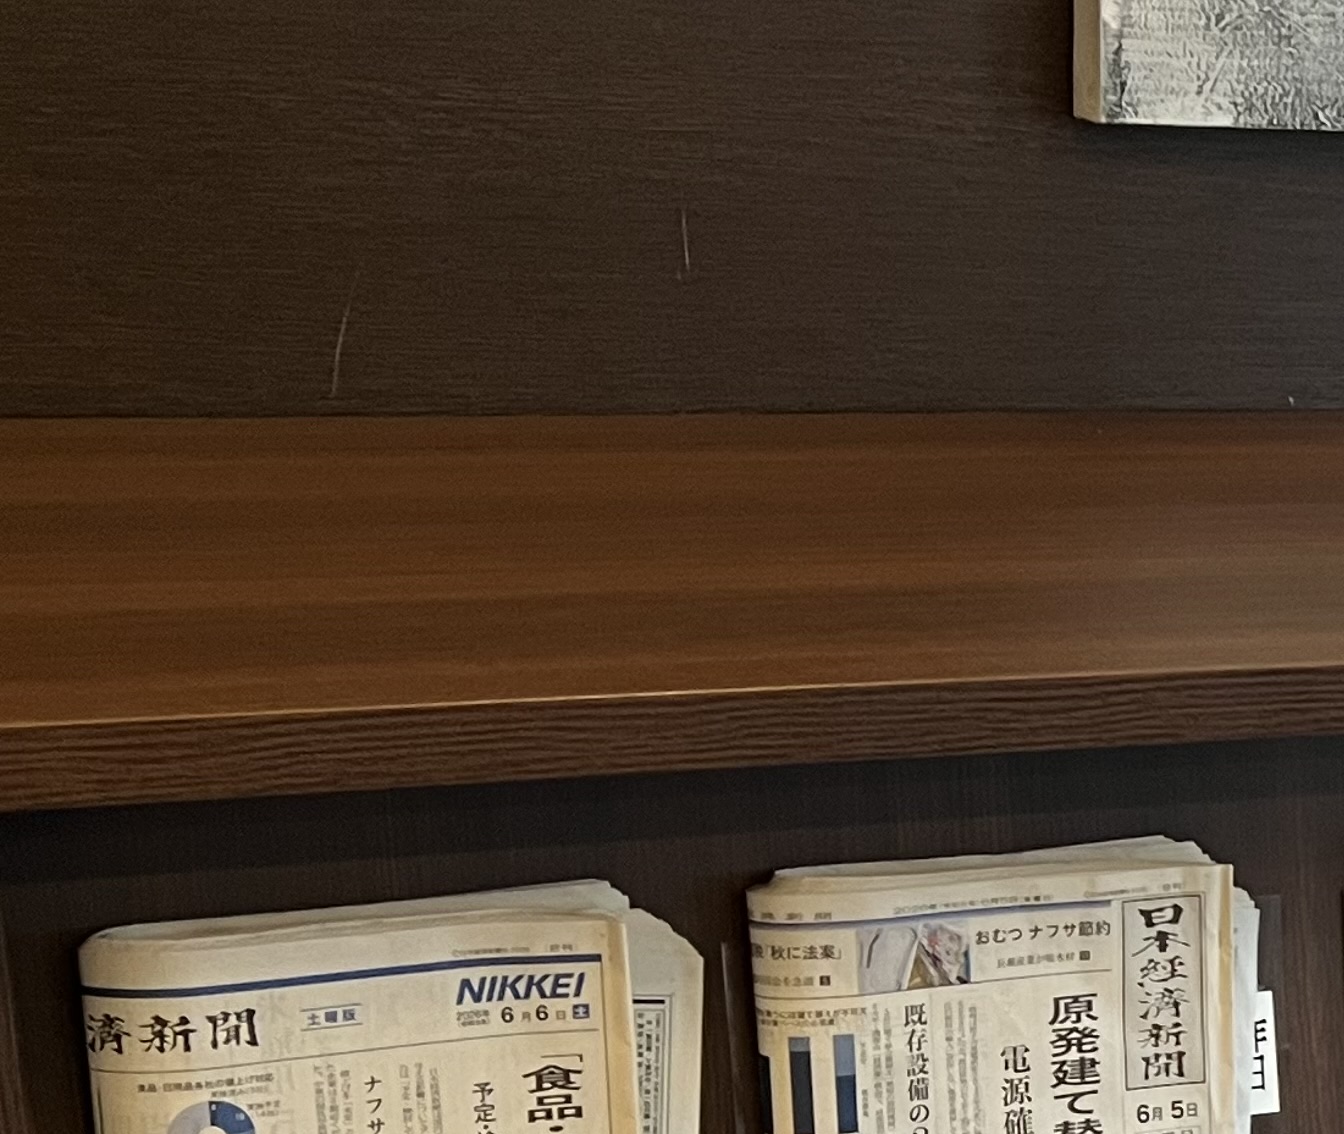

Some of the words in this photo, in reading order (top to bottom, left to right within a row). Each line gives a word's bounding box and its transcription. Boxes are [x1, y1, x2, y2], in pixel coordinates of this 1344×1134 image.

[976, 925, 1023, 945] おむつ
[1028, 920, 1111, 939] ナフサ節約
[456, 971, 586, 1006] NIKKEI
[306, 1006, 361, 1027] 土曜版
[1136, 1099, 1199, 1124] 6月5日
